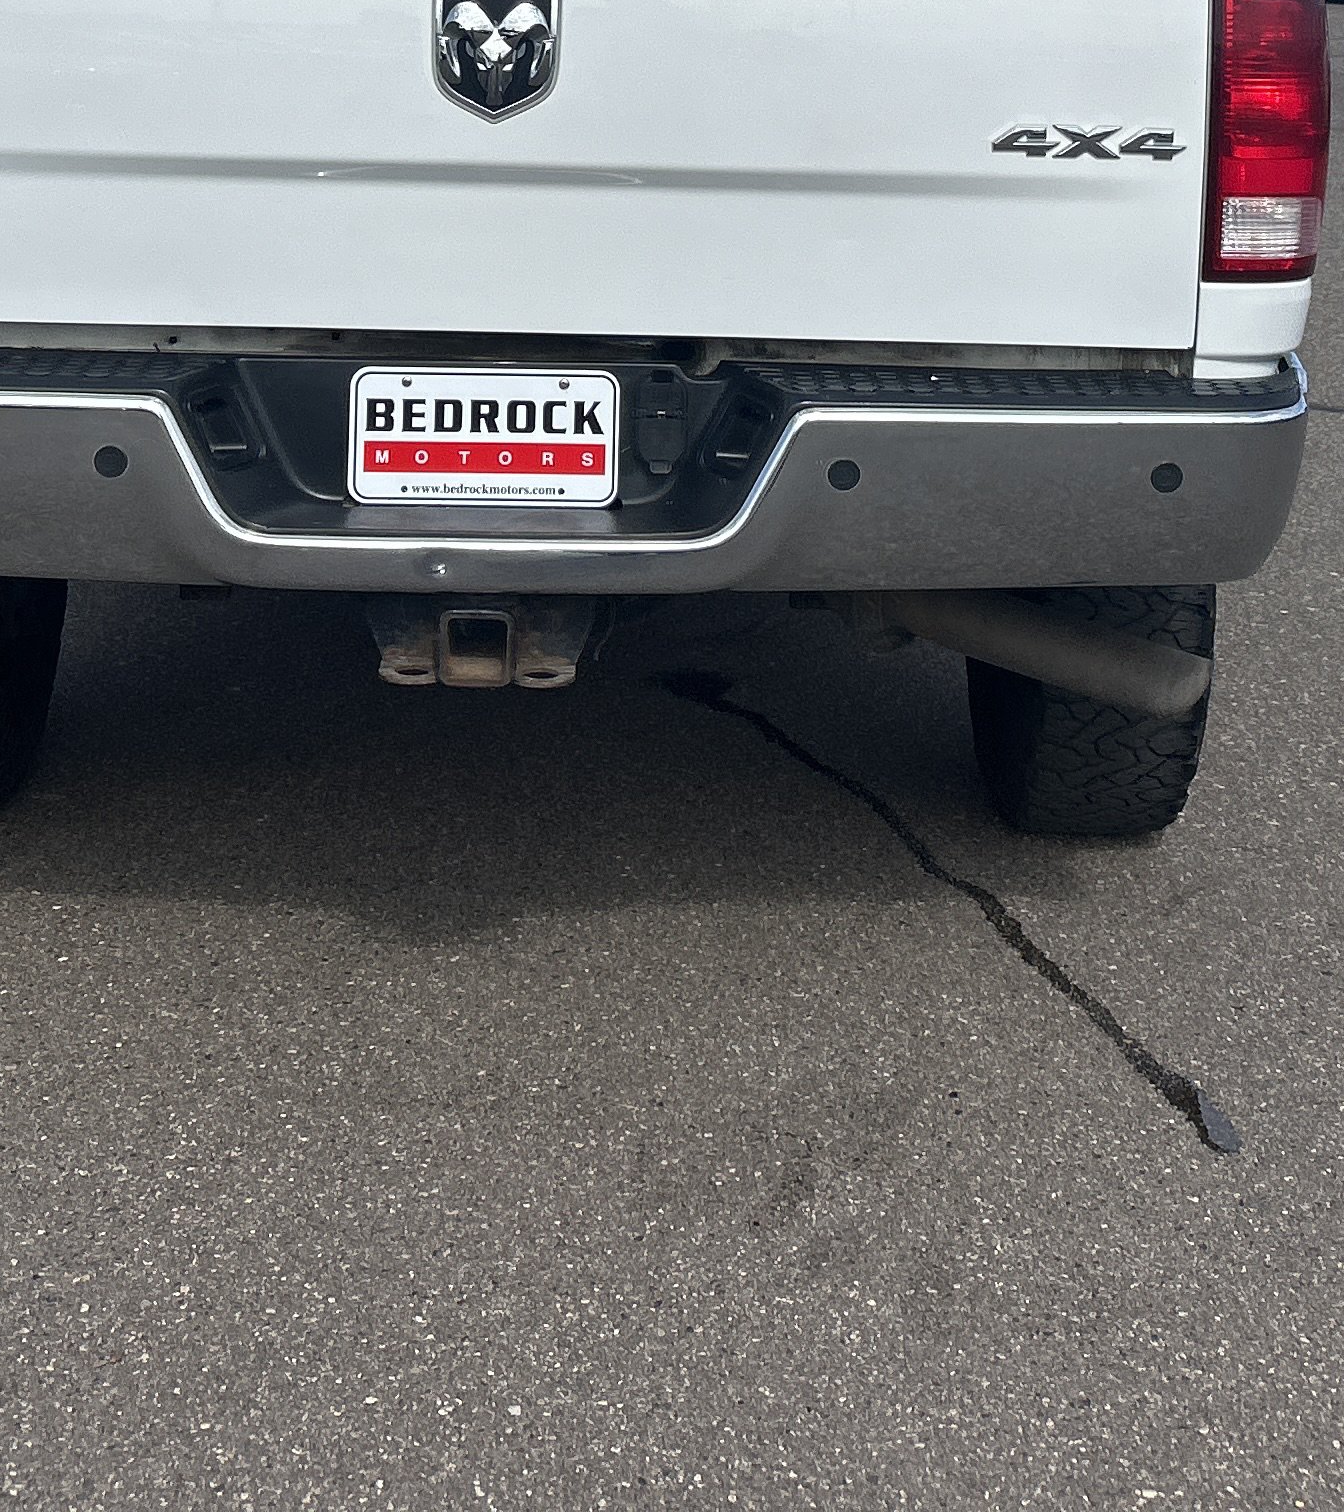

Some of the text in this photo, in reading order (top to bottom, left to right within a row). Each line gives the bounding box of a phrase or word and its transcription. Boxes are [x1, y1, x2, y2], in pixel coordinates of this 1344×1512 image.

[992, 124, 1187, 160] 4X4
[365, 398, 604, 435] BEDROCK
[375, 449, 594, 467] MOTORS
[412, 483, 556, 495] www.bedrockmotors.com
